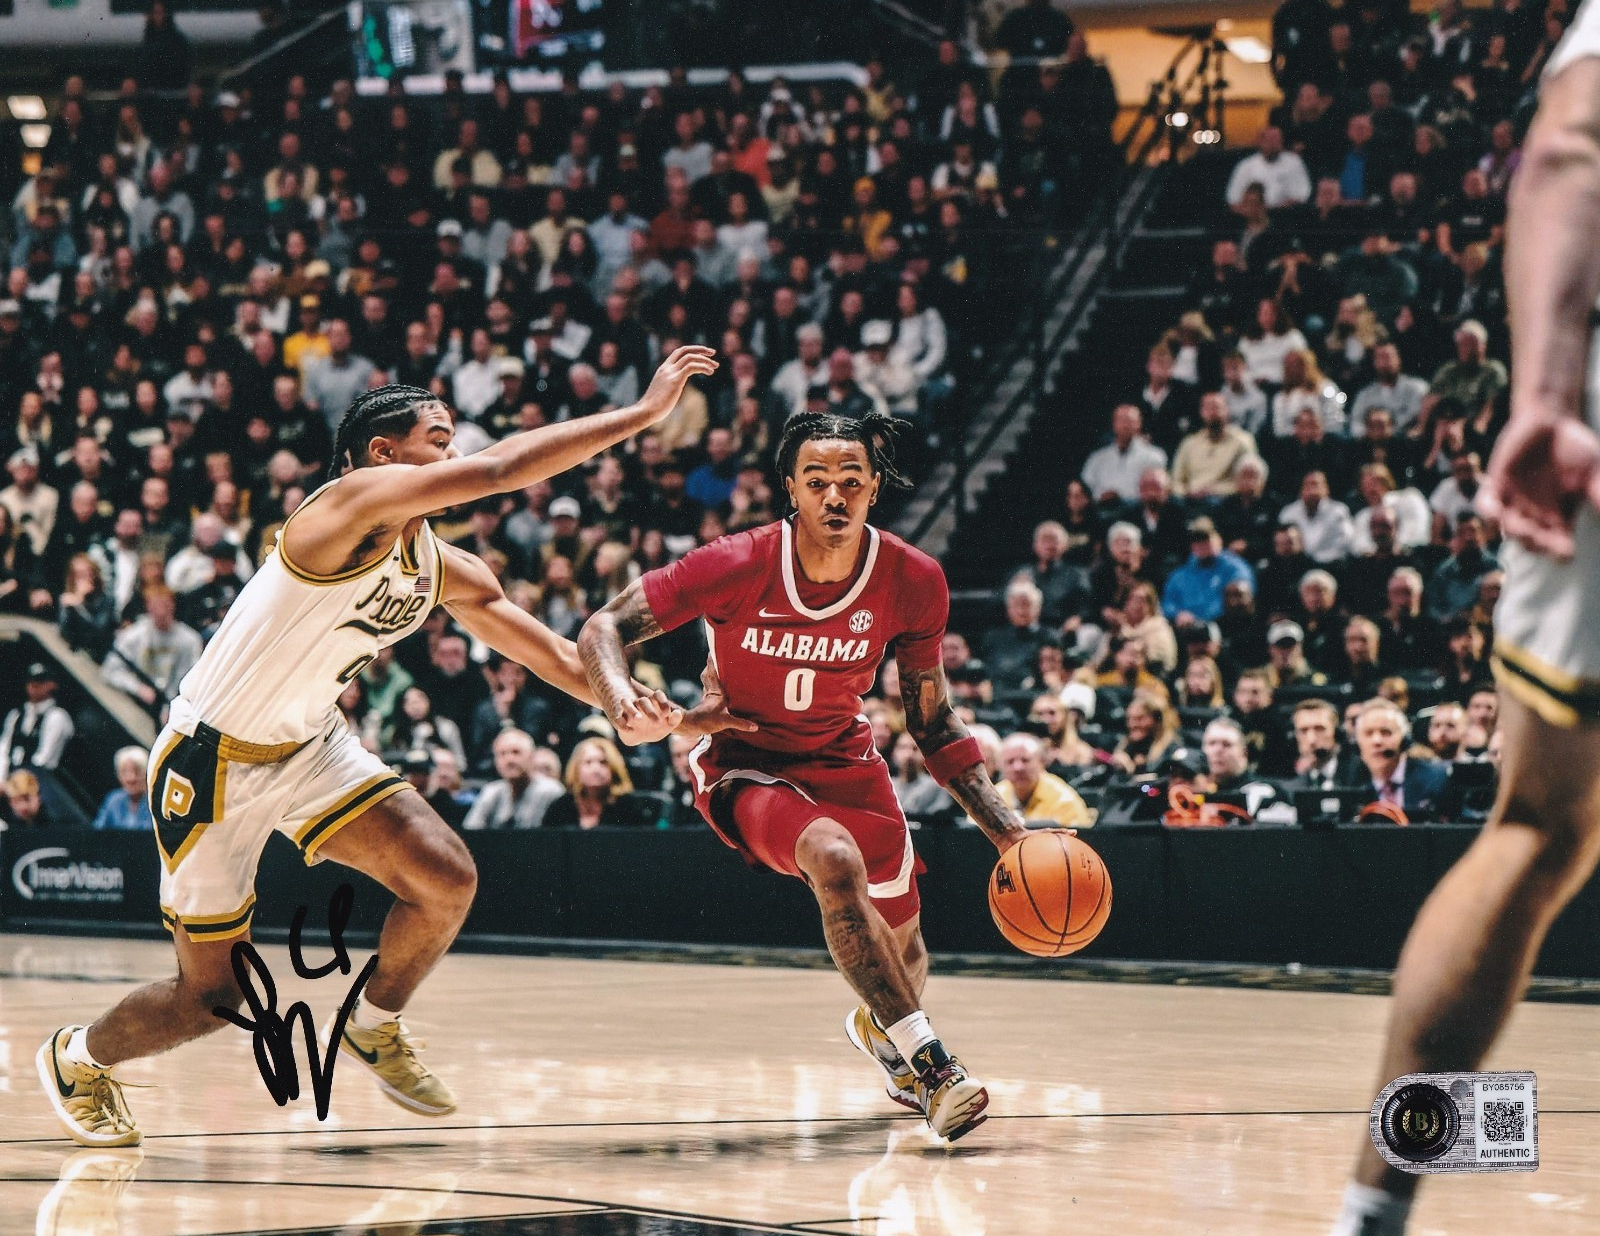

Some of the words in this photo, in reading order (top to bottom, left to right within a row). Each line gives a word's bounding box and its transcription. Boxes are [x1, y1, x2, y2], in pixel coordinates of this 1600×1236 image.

[850, 610, 873, 633] SEC
[741, 627, 870, 662] ALABAMA
[784, 667, 817, 712] 0
[161, 767, 196, 821] P
[1414, 1112, 1429, 1131] B
[1480, 1148, 1530, 1159] AUTHENTIC
